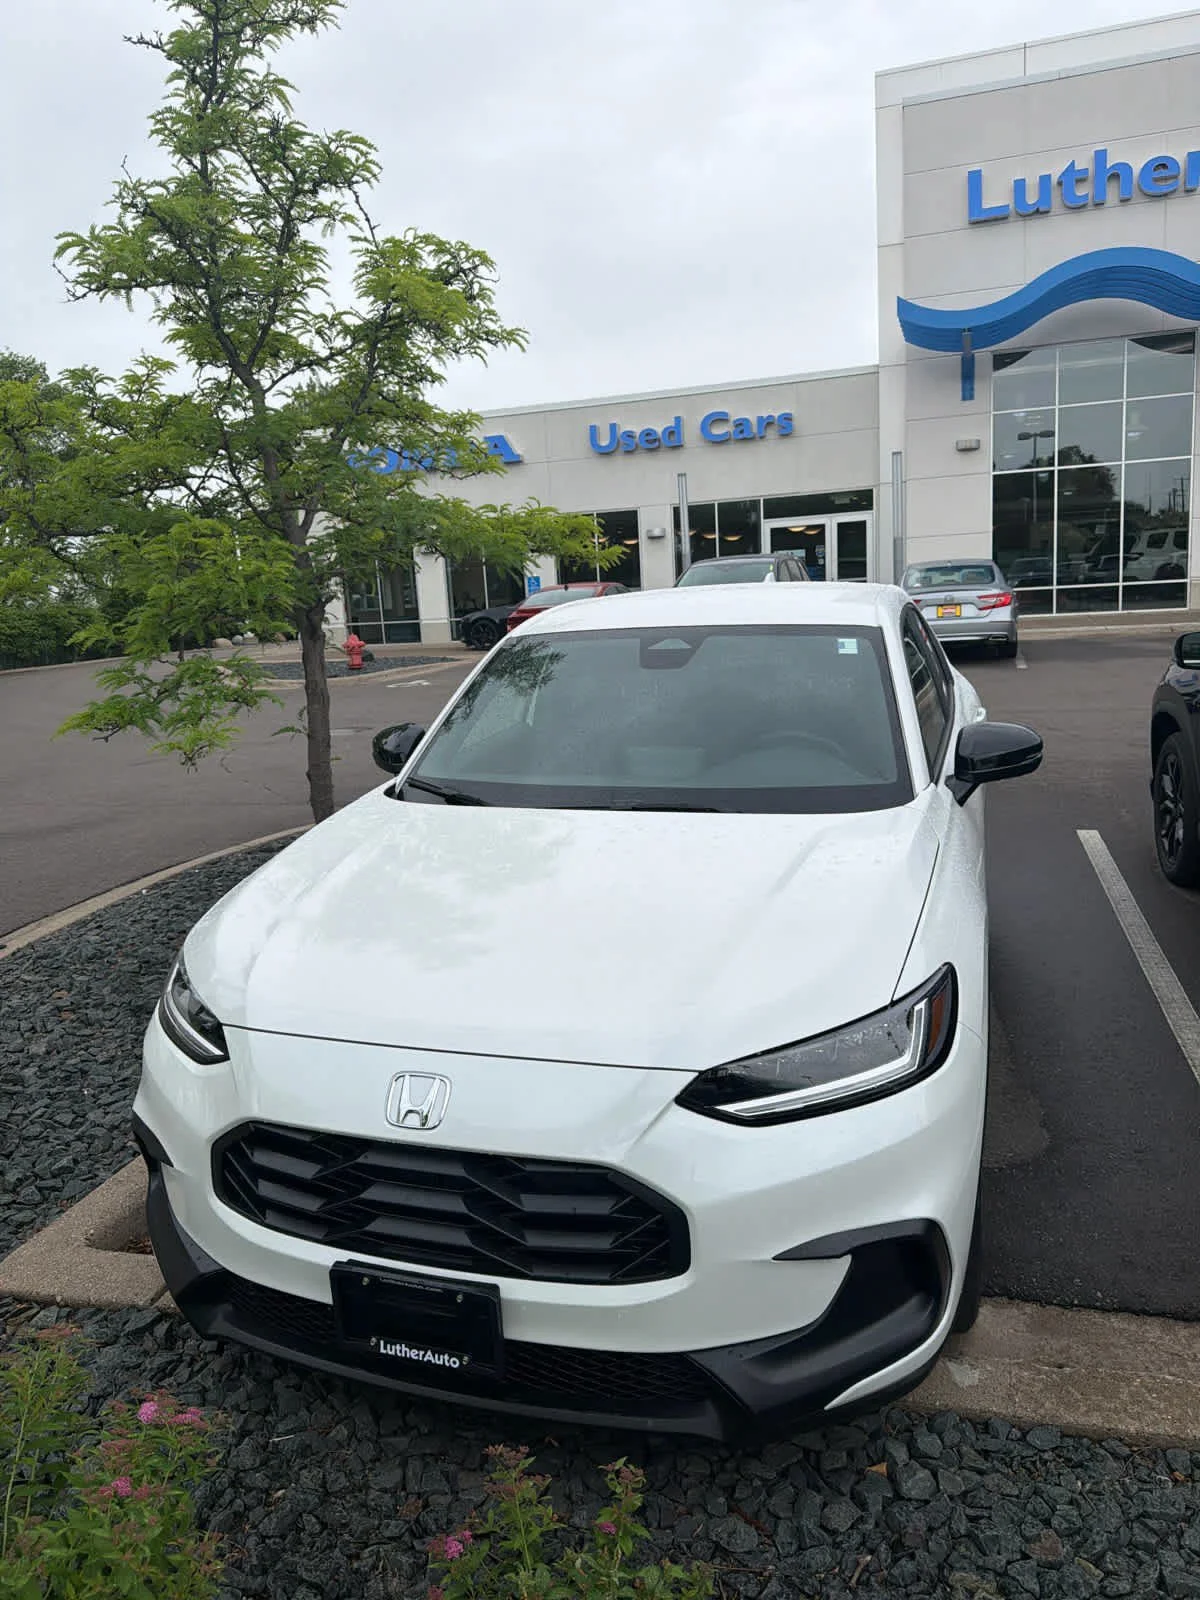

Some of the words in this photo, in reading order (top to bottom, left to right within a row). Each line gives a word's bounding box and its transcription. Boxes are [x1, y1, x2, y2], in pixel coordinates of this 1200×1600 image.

[588, 415, 684, 454] Used
[699, 410, 795, 443] Cars
[379, 1339, 460, 1368] LutherAuto
